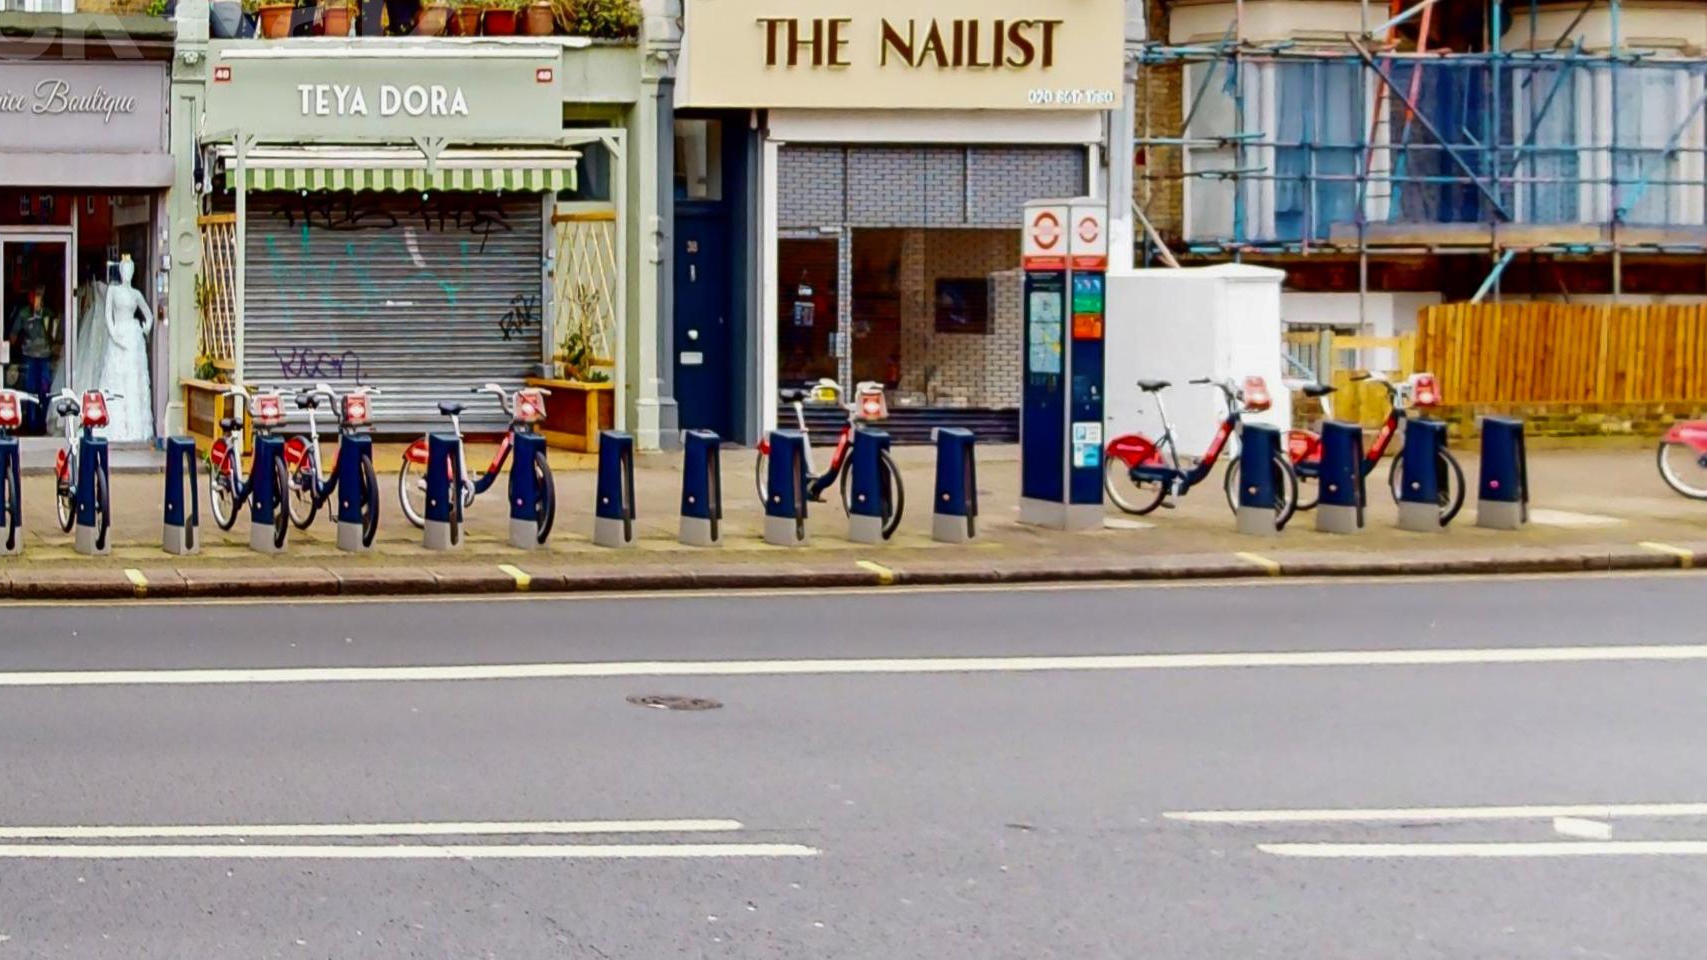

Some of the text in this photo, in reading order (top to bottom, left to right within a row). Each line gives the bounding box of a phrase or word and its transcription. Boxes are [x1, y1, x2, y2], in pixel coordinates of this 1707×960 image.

[757, 18, 1064, 68] THE NAILIST
[215, 70, 230, 80] 40
[537, 71, 552, 81] 40
[32, 77, 136, 123] Boutique
[297, 83, 469, 116] TEYA DORA
[1028, 88, 1054, 104] 020
